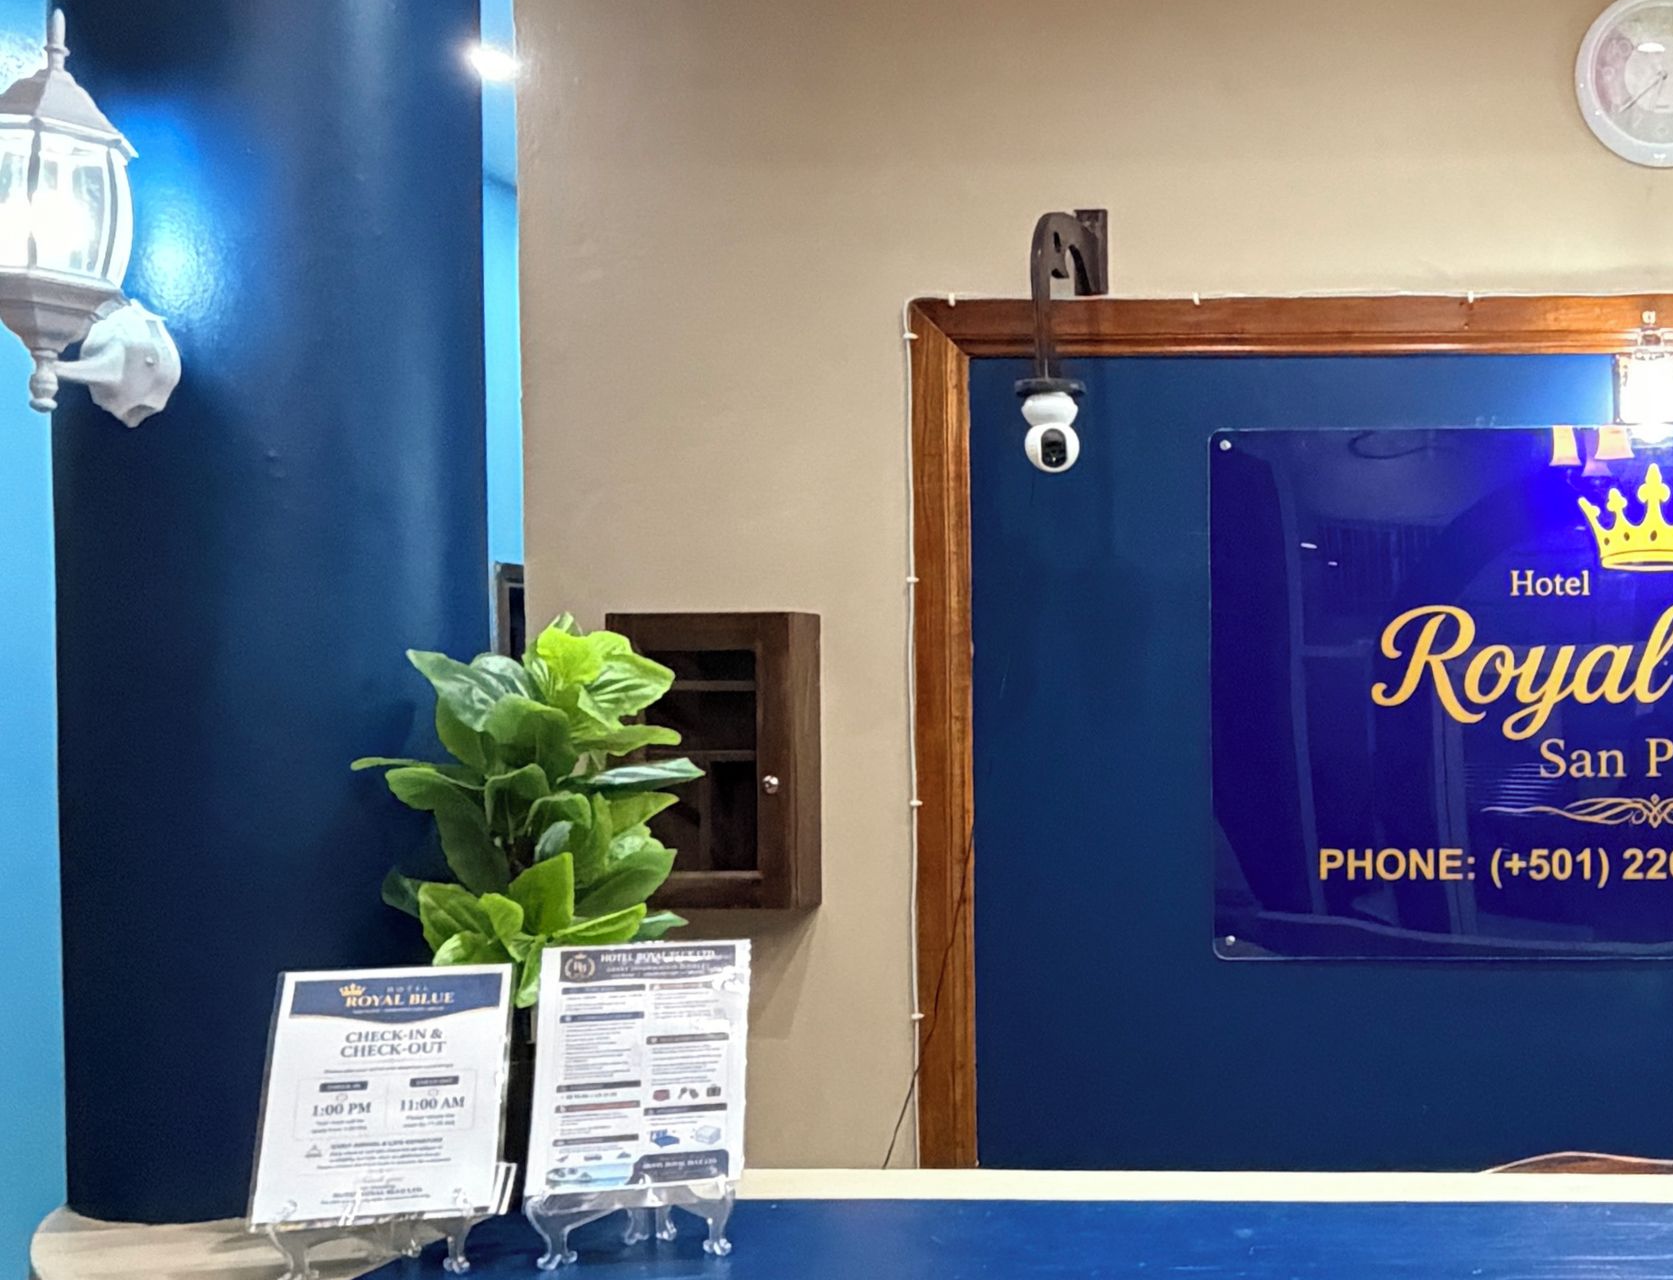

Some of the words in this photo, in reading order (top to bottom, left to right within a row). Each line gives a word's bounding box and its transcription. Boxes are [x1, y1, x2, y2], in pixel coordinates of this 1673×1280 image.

[1510, 569, 1590, 597] Hotel
[1539, 739, 1626, 778] San
[1319, 848, 1475, 881] PHONE:
[1491, 847, 1610, 888] (+501)
[344, 994, 405, 1008] ROYAL
[408, 991, 456, 1006] BLUE
[345, 1028, 428, 1044] CHECK-IN
[430, 1028, 443, 1039] &
[340, 1040, 447, 1058] CHECK-OUT
[312, 1103, 344, 1117] 1:00
[347, 1102, 372, 1115] PM
[400, 1098, 438, 1111] 11:00
[440, 1096, 465, 1109] AM
